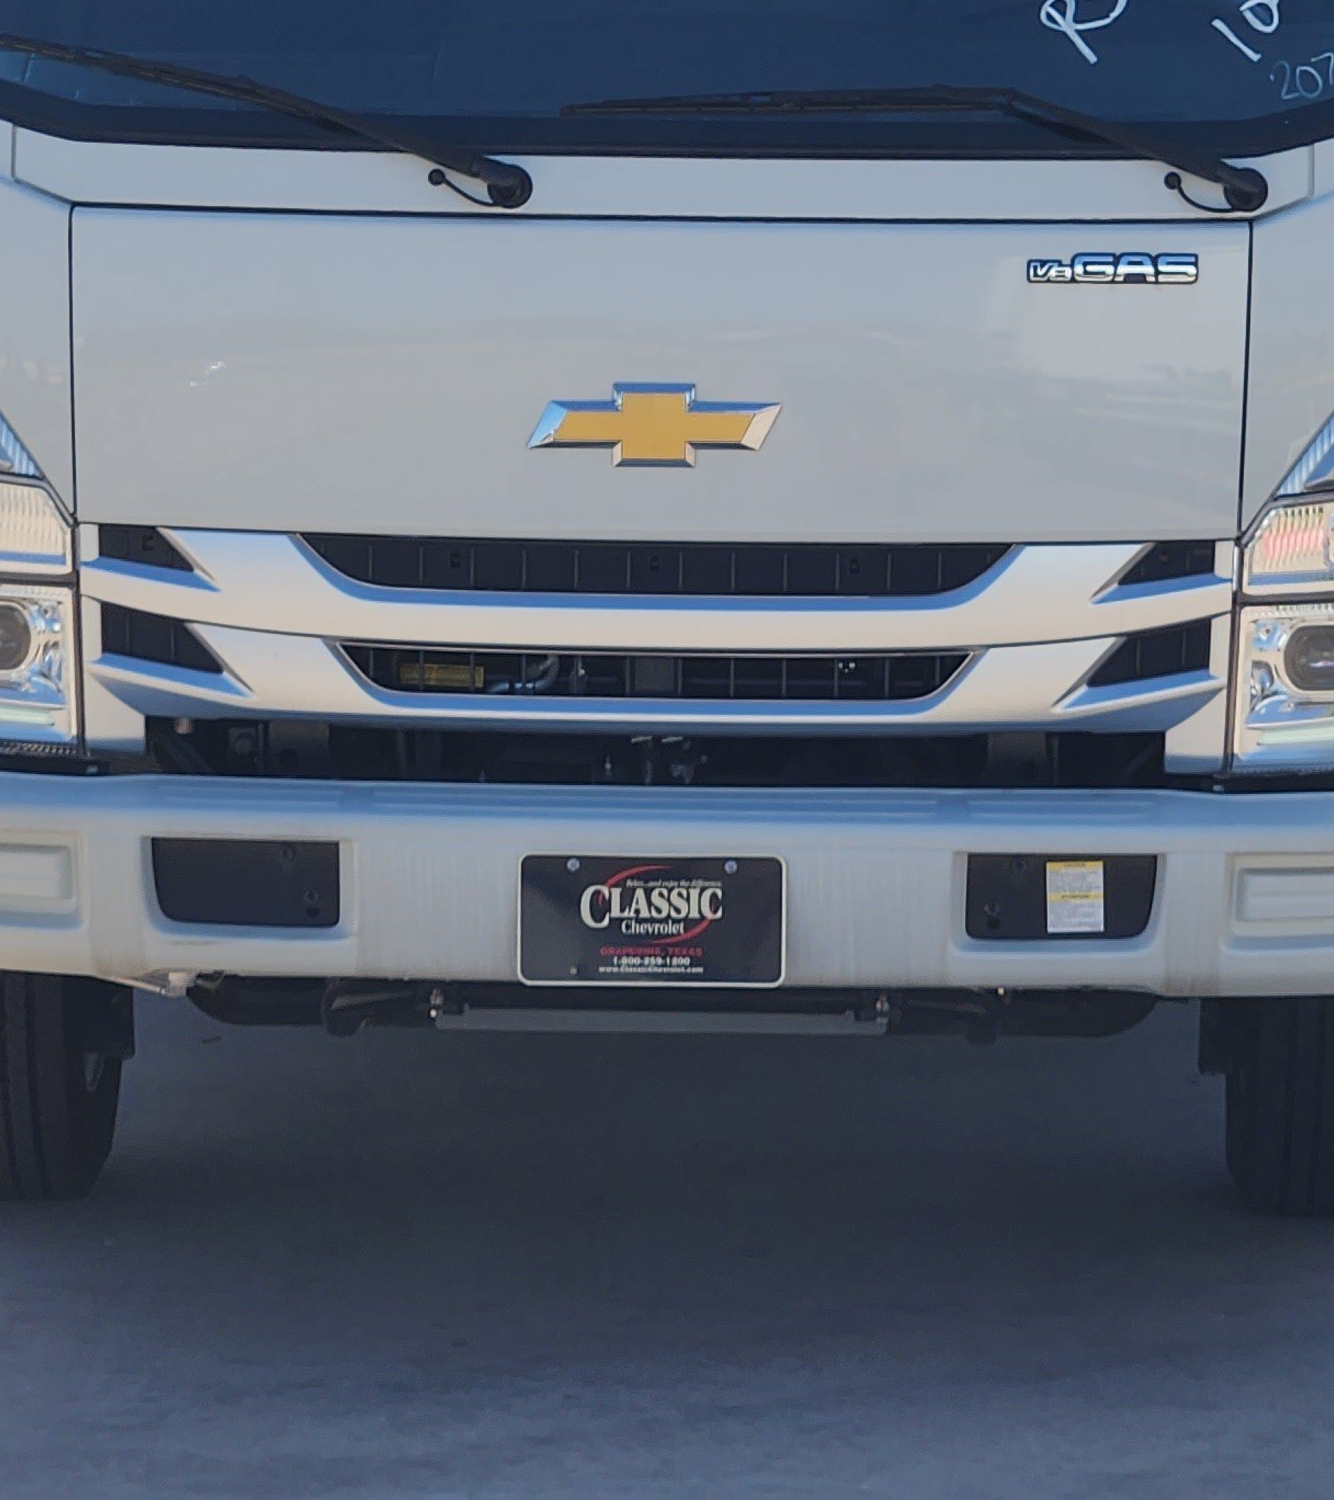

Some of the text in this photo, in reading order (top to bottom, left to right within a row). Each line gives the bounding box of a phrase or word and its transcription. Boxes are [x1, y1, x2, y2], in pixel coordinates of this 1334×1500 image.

[1072, 253, 1199, 284] GAS
[580, 884, 723, 929] CLASSIC
[621, 919, 685, 935] Chevrolet
